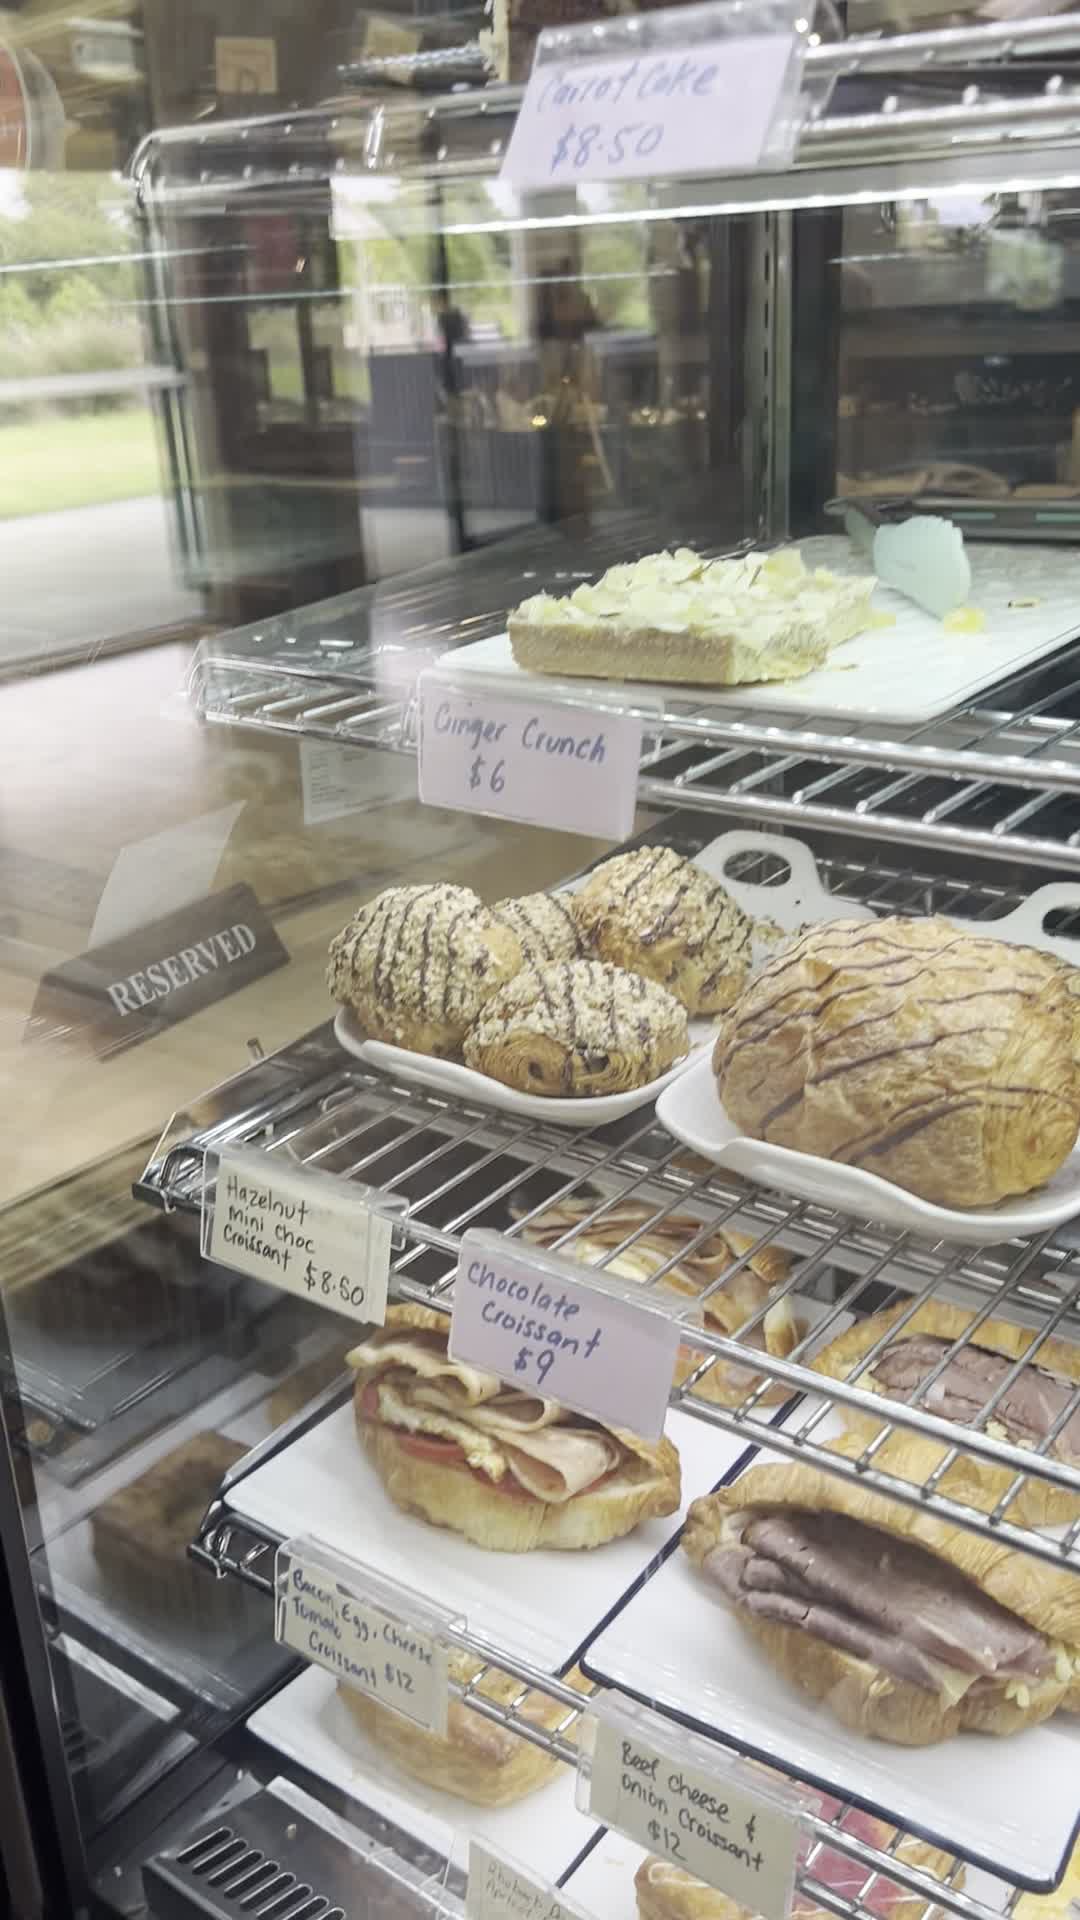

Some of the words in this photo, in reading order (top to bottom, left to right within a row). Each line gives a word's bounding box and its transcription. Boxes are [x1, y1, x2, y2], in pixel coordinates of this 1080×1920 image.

[537, 61, 639, 112] Carrot
[638, 58, 719, 100] Cake
[552, 122, 665, 173] $8.50
[434, 701, 507, 750] Ginger
[521, 717, 606, 763] Crunch
[469, 755, 505, 792] $6
[106, 923, 256, 1017] RESERVED
[227, 1175, 309, 1224] Hazelnut
[224, 1223, 291, 1272] Croissant
[304, 1260, 364, 1306] $8.50
[468, 1261, 580, 1321] Chocolate
[482, 1301, 602, 1358] Croissant
[514, 1346, 554, 1384] $9
[384, 1662, 415, 1694] $12
[621, 1741, 659, 1781] Beef
[647, 1819, 687, 1862] $12
